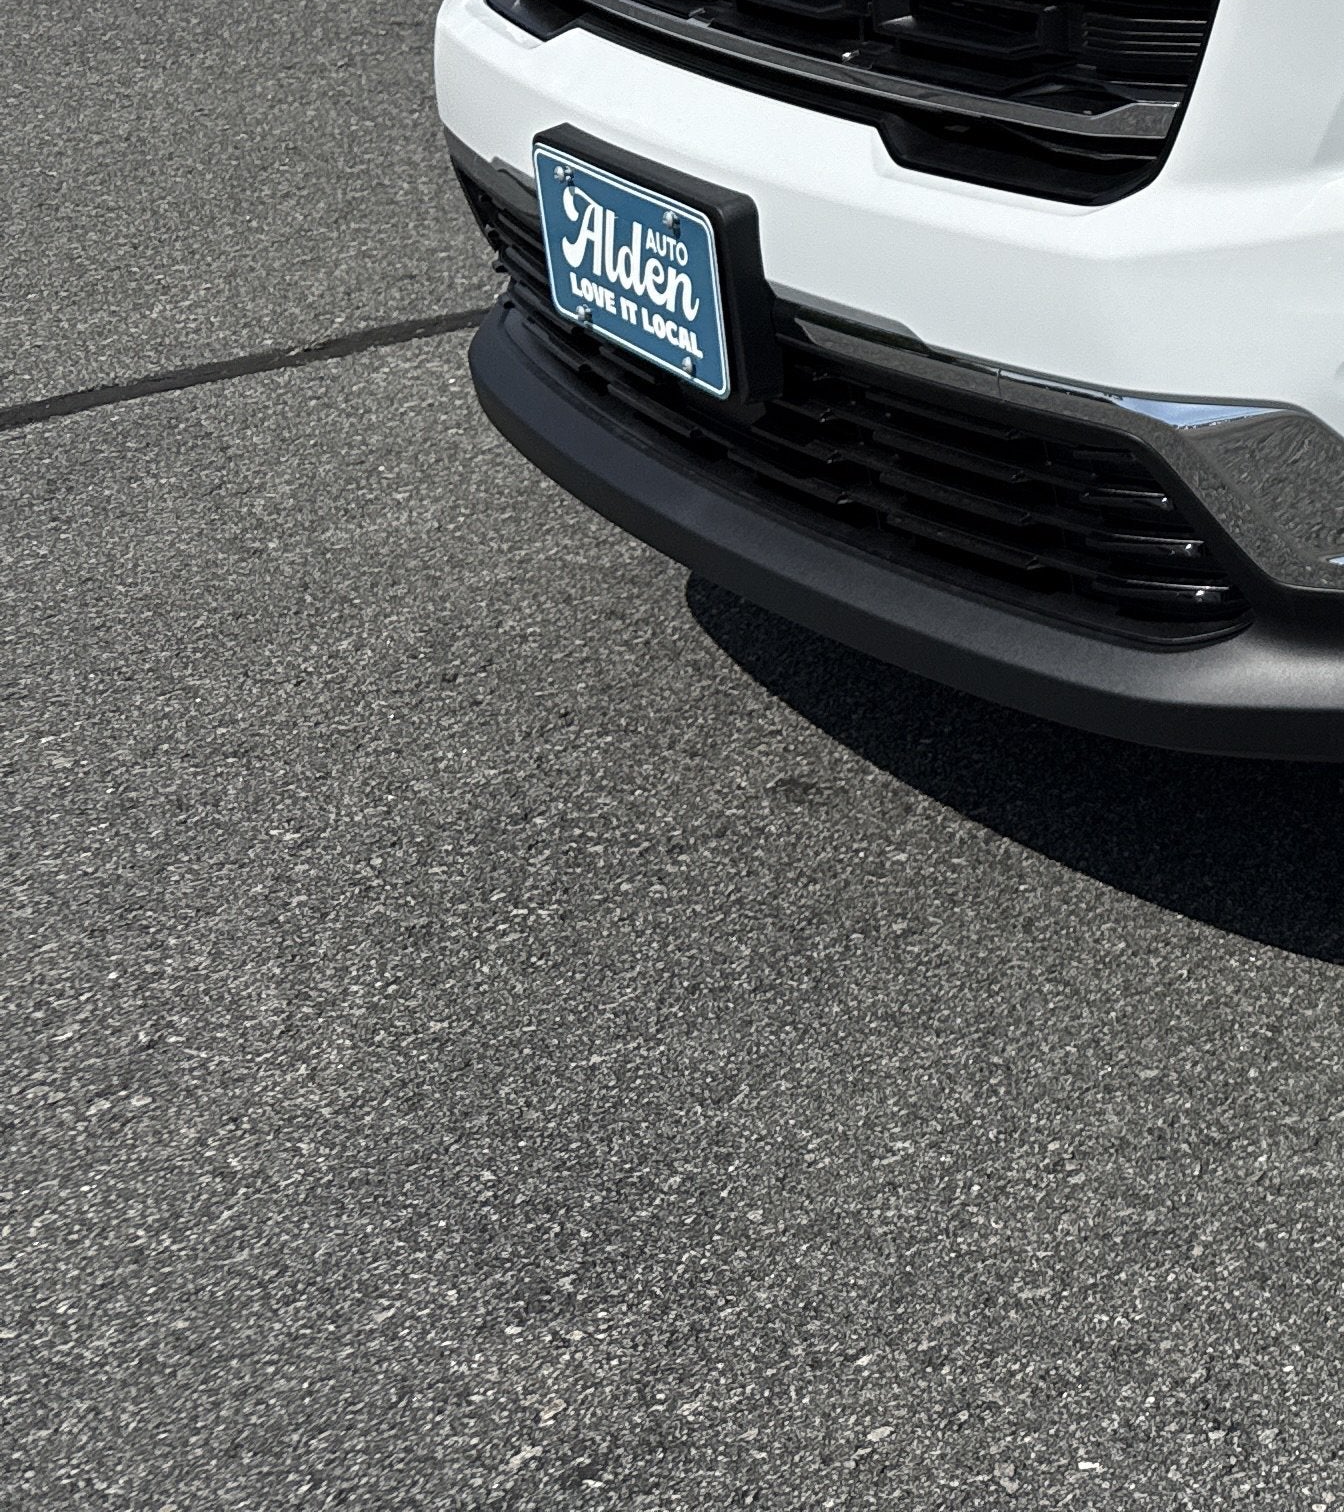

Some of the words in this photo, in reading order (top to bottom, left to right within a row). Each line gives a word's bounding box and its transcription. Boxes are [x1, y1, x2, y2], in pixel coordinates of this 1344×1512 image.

[562, 186, 700, 322] Alden
[645, 228, 689, 267] AUTO
[569, 271, 617, 315] LOVE
[619, 296, 638, 325] IT
[641, 307, 704, 359] LOCAL
